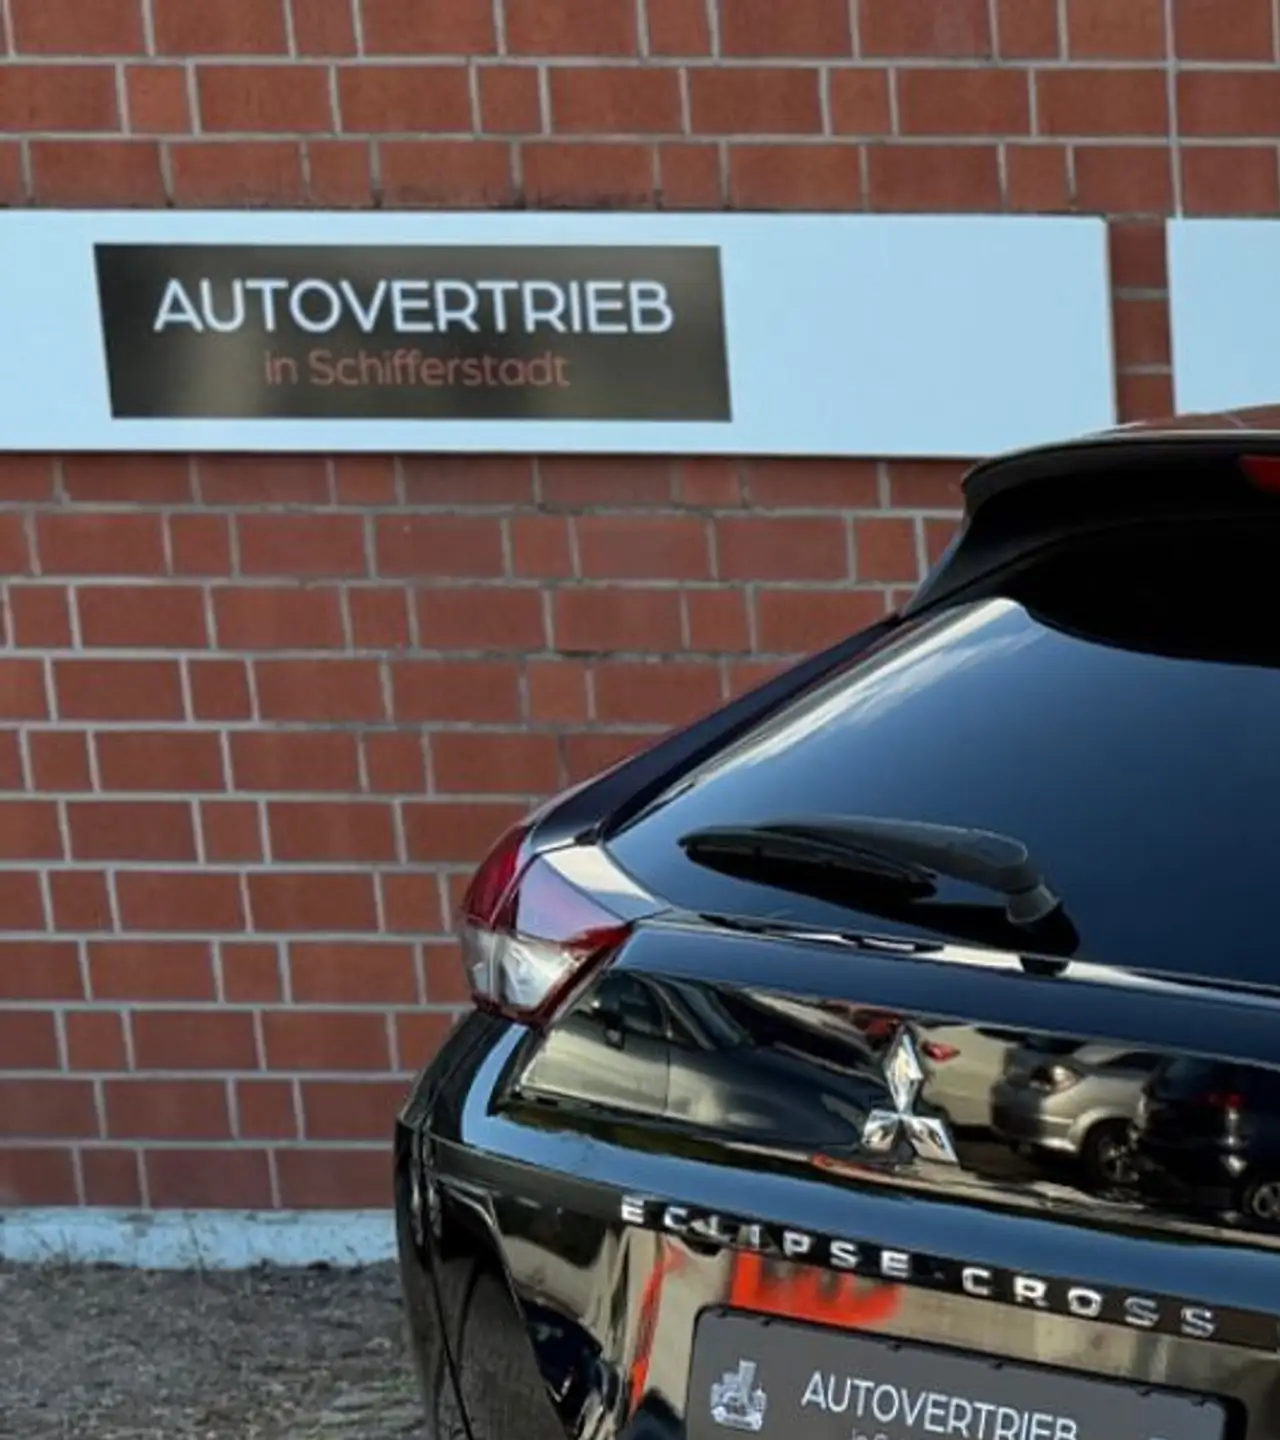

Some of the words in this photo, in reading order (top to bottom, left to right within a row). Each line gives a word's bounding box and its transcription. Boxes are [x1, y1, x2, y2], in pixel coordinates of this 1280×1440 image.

[152, 278, 675, 334] AUTOVERTRIEB
[264, 351, 298, 384] in
[308, 349, 571, 387] Schifferstadt
[620, 1195, 911, 1279] ECLIPSE
[961, 1265, 1217, 1339] CROSS
